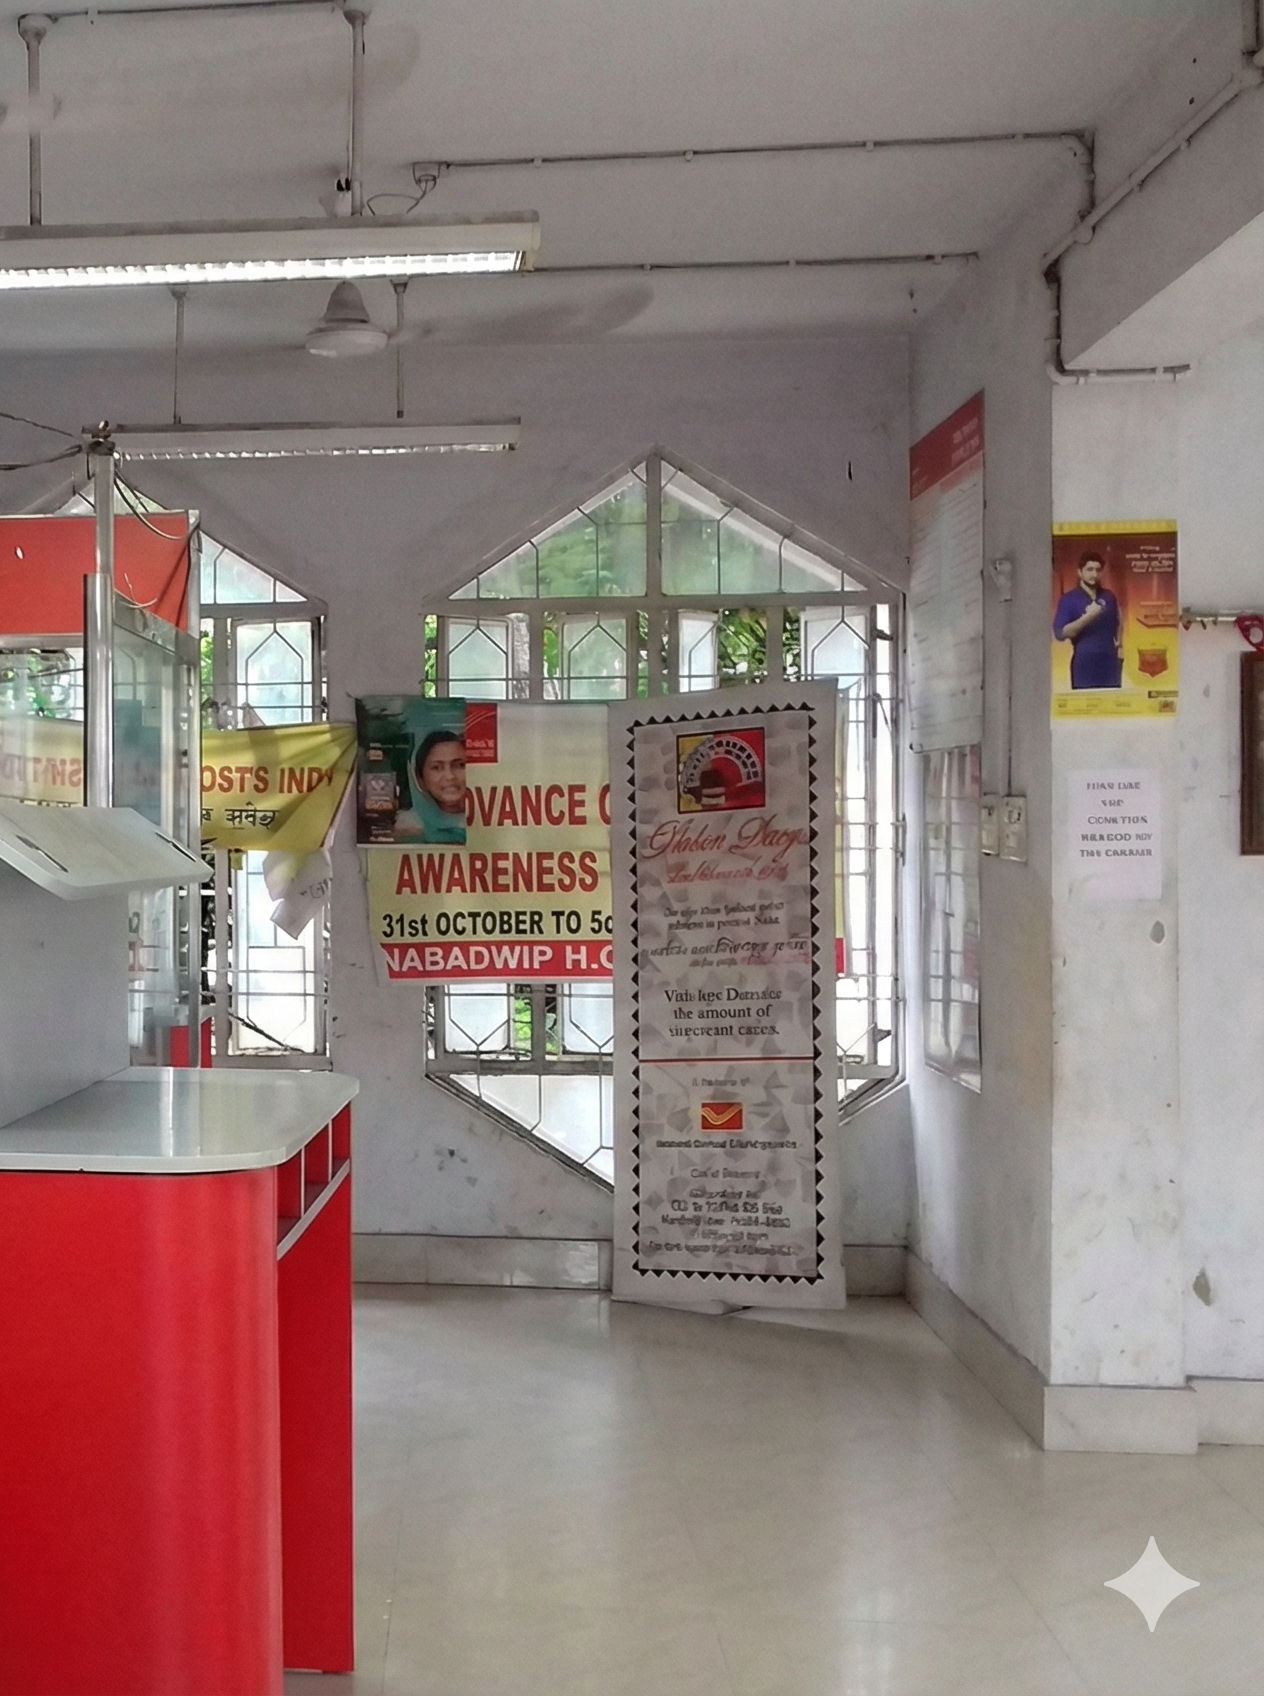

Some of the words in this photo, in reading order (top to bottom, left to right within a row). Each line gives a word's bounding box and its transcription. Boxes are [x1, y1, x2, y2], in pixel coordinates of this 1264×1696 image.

[395, 850, 599, 895] AWARENESS
[382, 912, 429, 938] 31st
[435, 910, 544, 936] OCTOBER
[551, 910, 582, 935] TO
[382, 945, 553, 972] NABADWIP
[697, 1006, 752, 1019] amount
[755, 1004, 773, 1017] of
